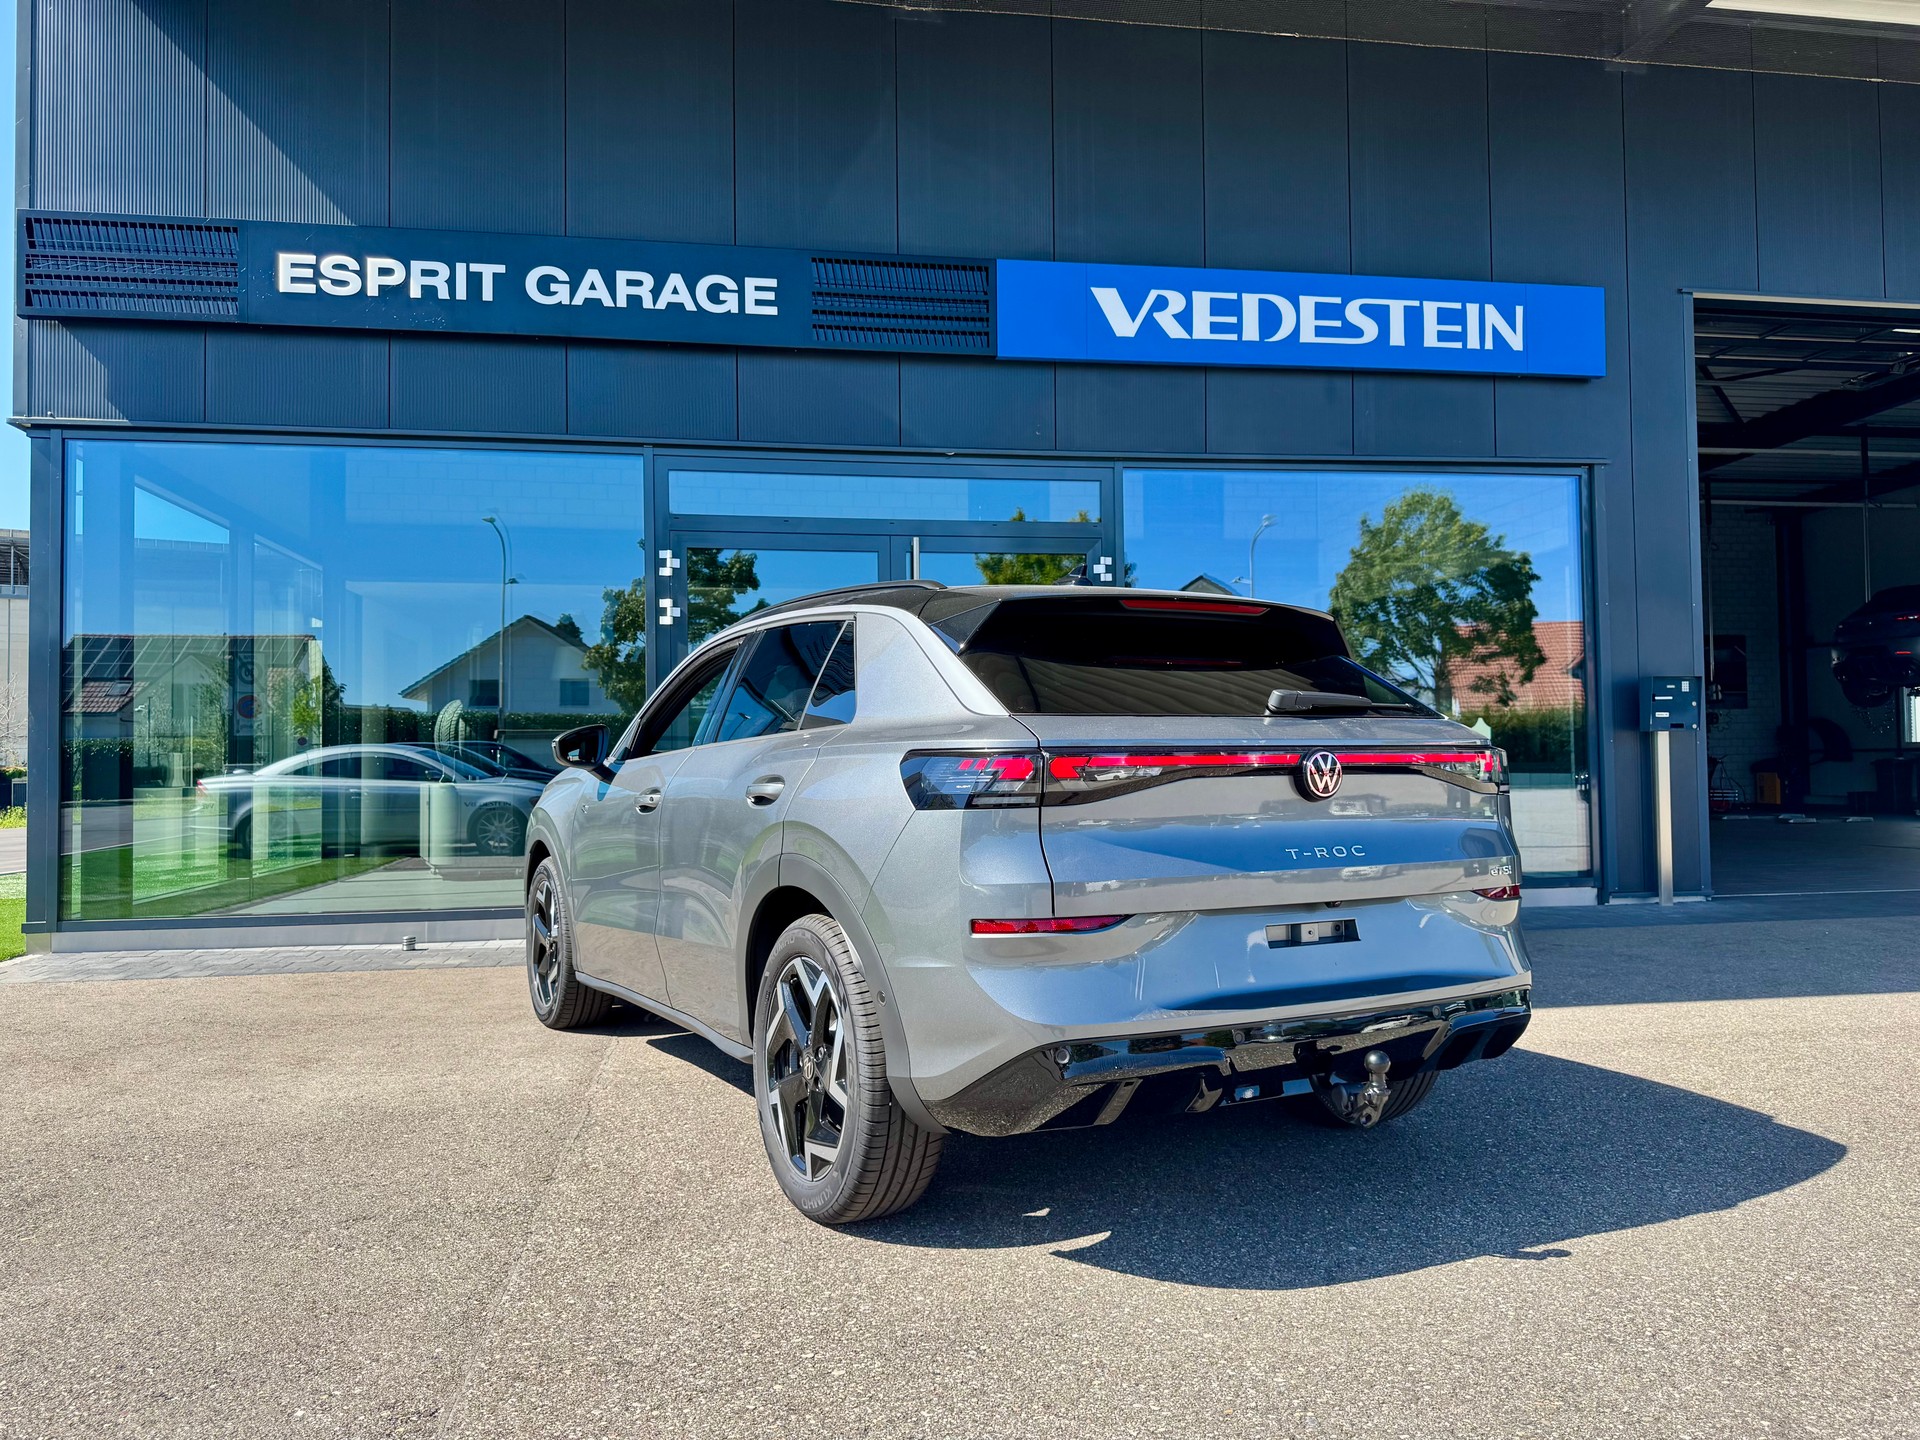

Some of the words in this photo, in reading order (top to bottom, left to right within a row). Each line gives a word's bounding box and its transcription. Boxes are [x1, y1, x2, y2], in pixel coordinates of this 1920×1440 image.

[278, 253, 506, 301] ESPRIT
[525, 265, 778, 316] GARAGE
[1090, 286, 1524, 352] VREDESTEIN
[1285, 845, 1366, 860] T-ROC
[801, 1184, 833, 1210] KUMHO
